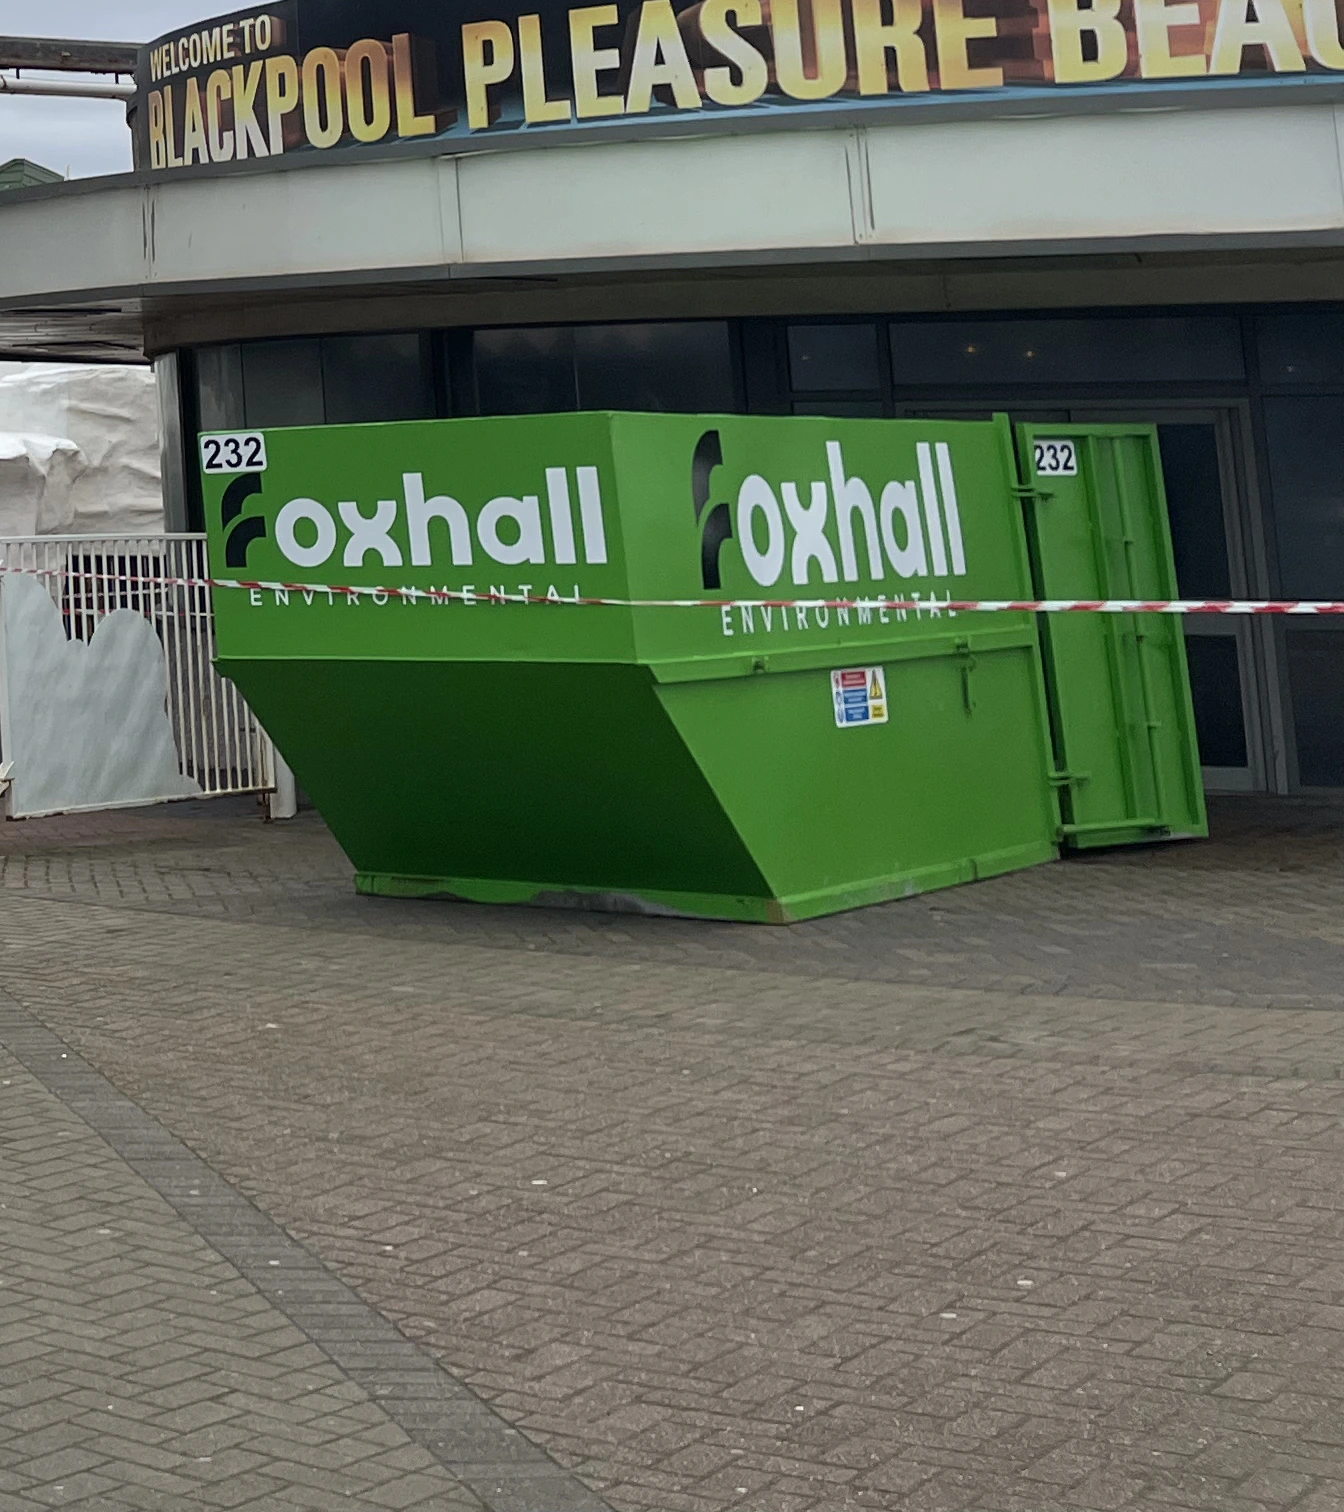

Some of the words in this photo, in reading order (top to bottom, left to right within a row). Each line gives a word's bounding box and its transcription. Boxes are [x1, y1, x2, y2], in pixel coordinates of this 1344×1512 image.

[150, 23, 235, 82] WELCOME
[241, 15, 272, 54] TO
[149, 33, 436, 170] BLACKPOOL
[203, 437, 264, 469] 232
[1034, 444, 1074, 471] 232
[250, 584, 583, 606] ENVIRONMENTAL
[721, 590, 957, 636] ENVIRONMENTAL
